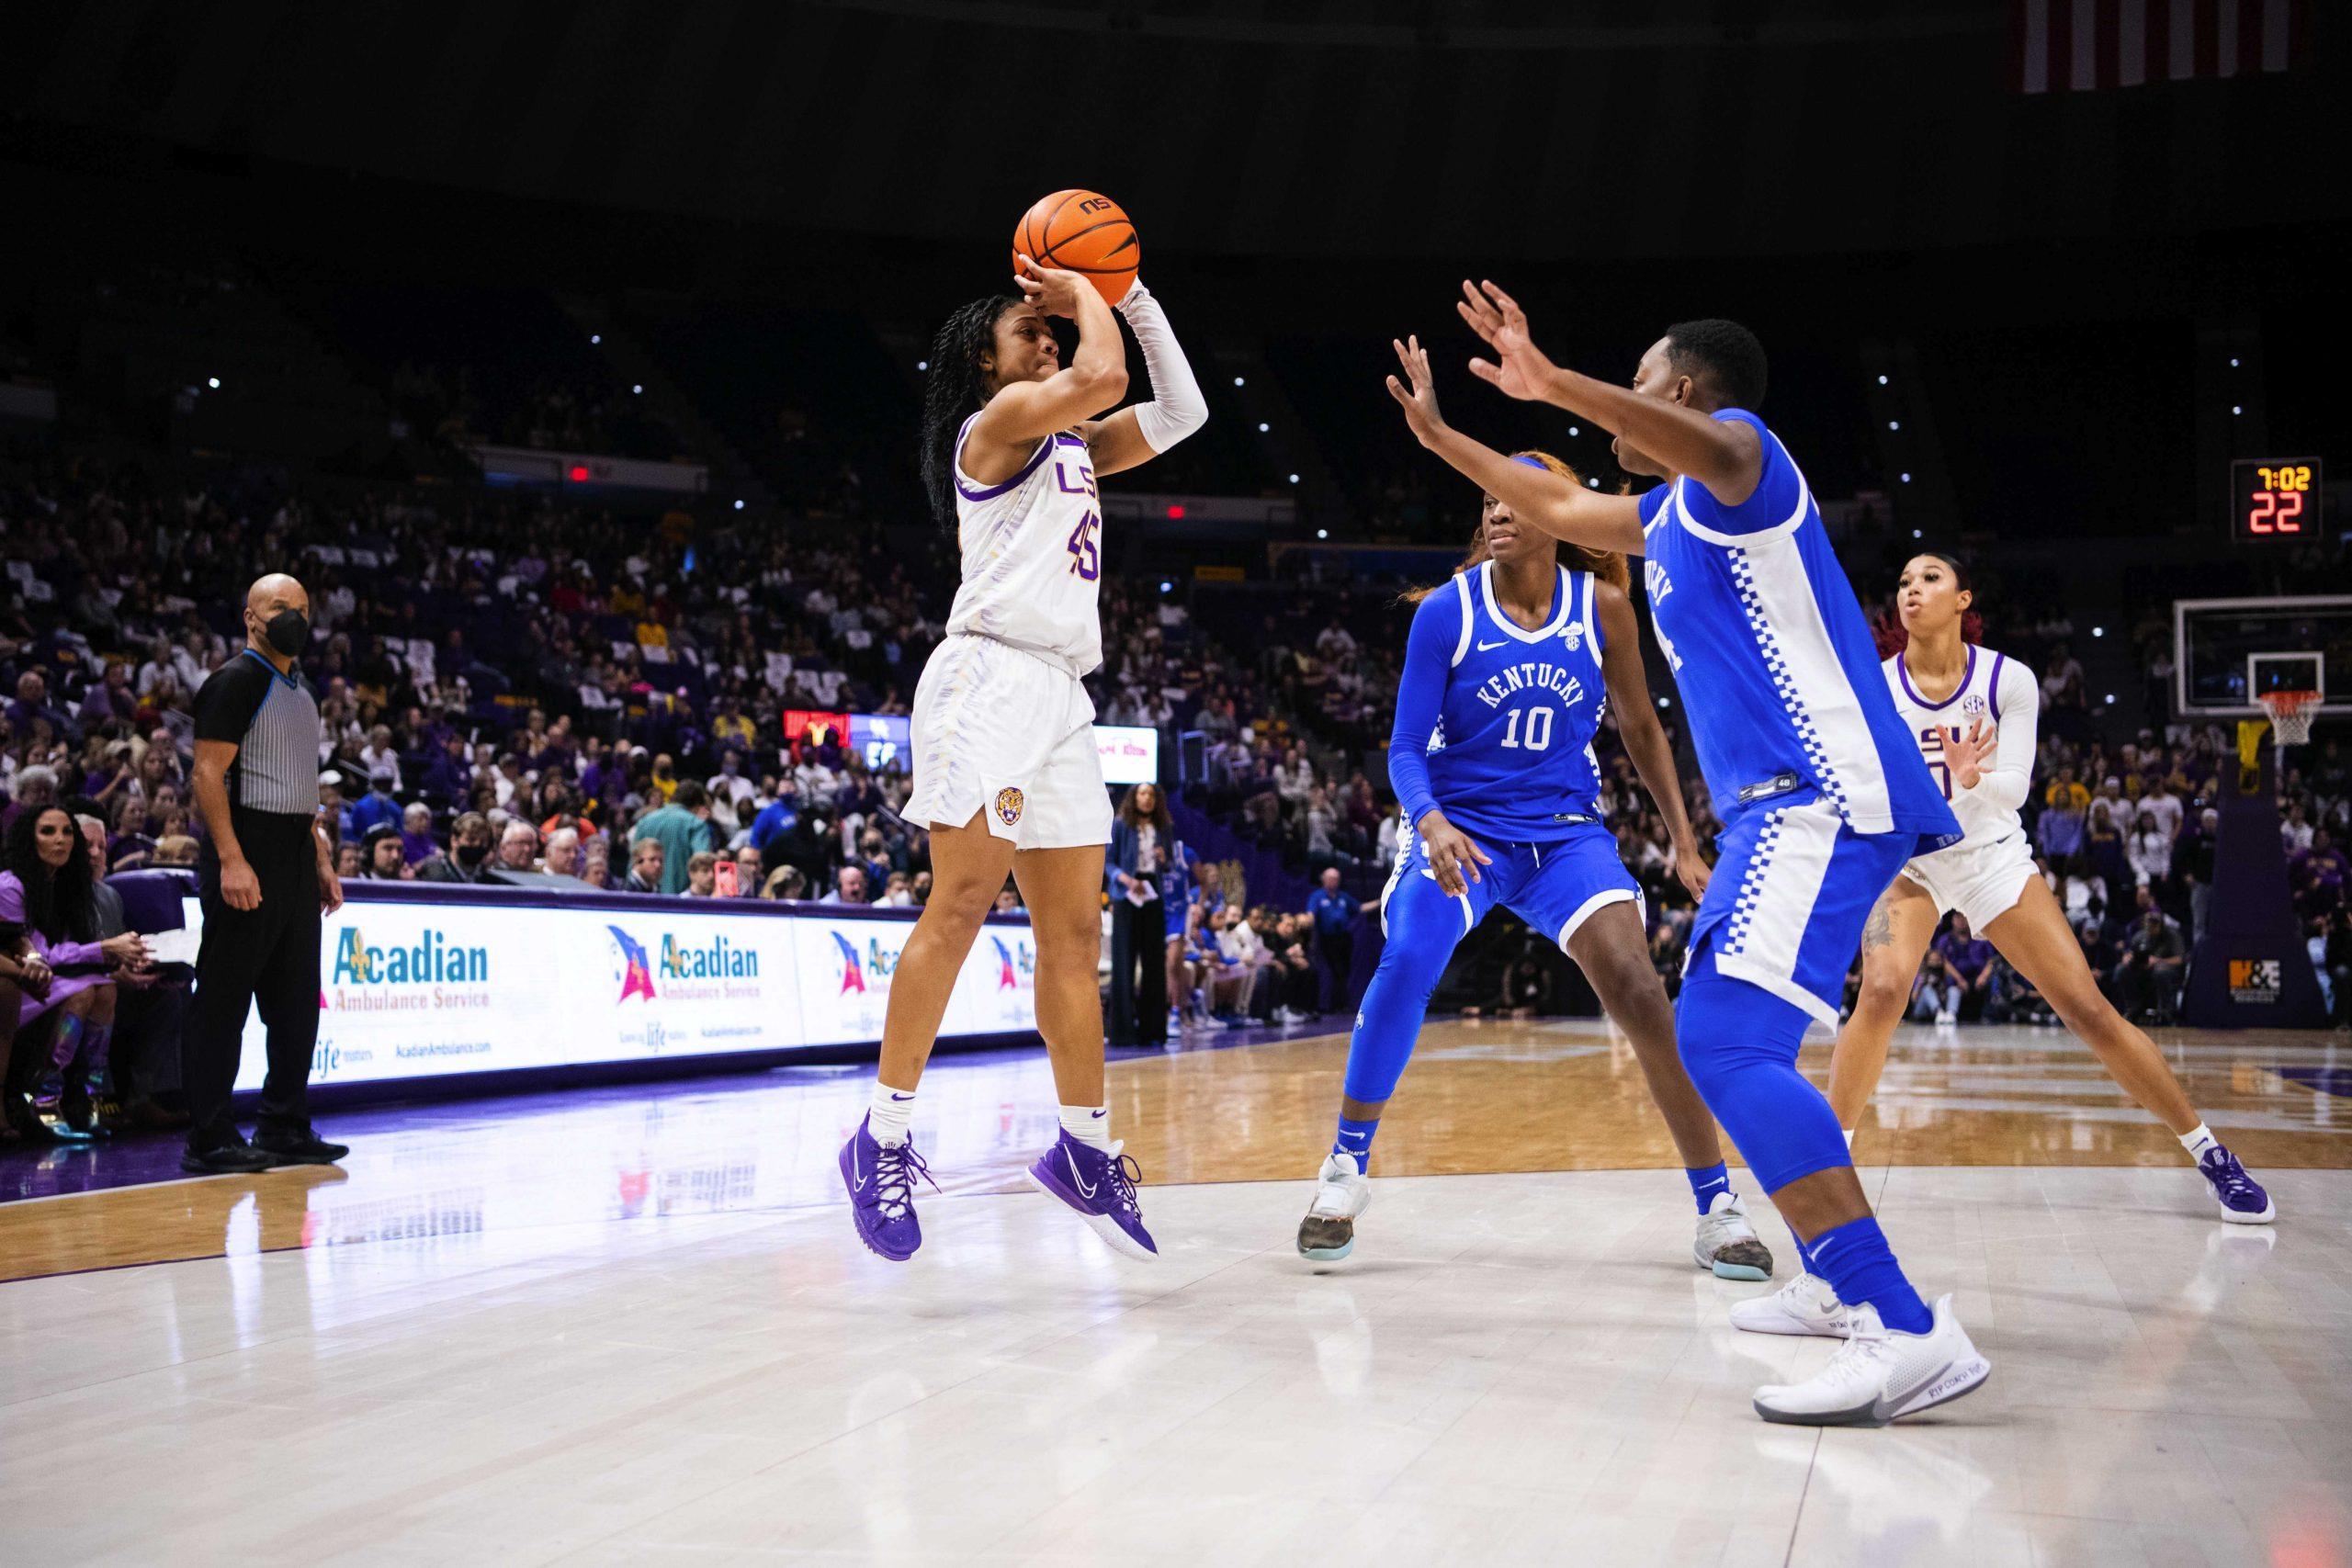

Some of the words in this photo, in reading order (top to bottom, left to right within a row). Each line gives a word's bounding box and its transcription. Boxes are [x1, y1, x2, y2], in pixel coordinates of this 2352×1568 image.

[2257, 467, 2311, 491] 7:02
[2250, 492, 2302, 533] 22
[1068, 509, 1100, 581] 45
[1476, 662, 1584, 709] KENTUCKY
[1963, 695, 1984, 715] SEC
[1500, 705, 1555, 751] 10
[1778, 778, 1791, 787] 48
[333, 927, 488, 985] Acadian
[659, 932, 759, 978] Acadian
[334, 987, 428, 1010] Ambulance
[434, 987, 491, 1009] Service
